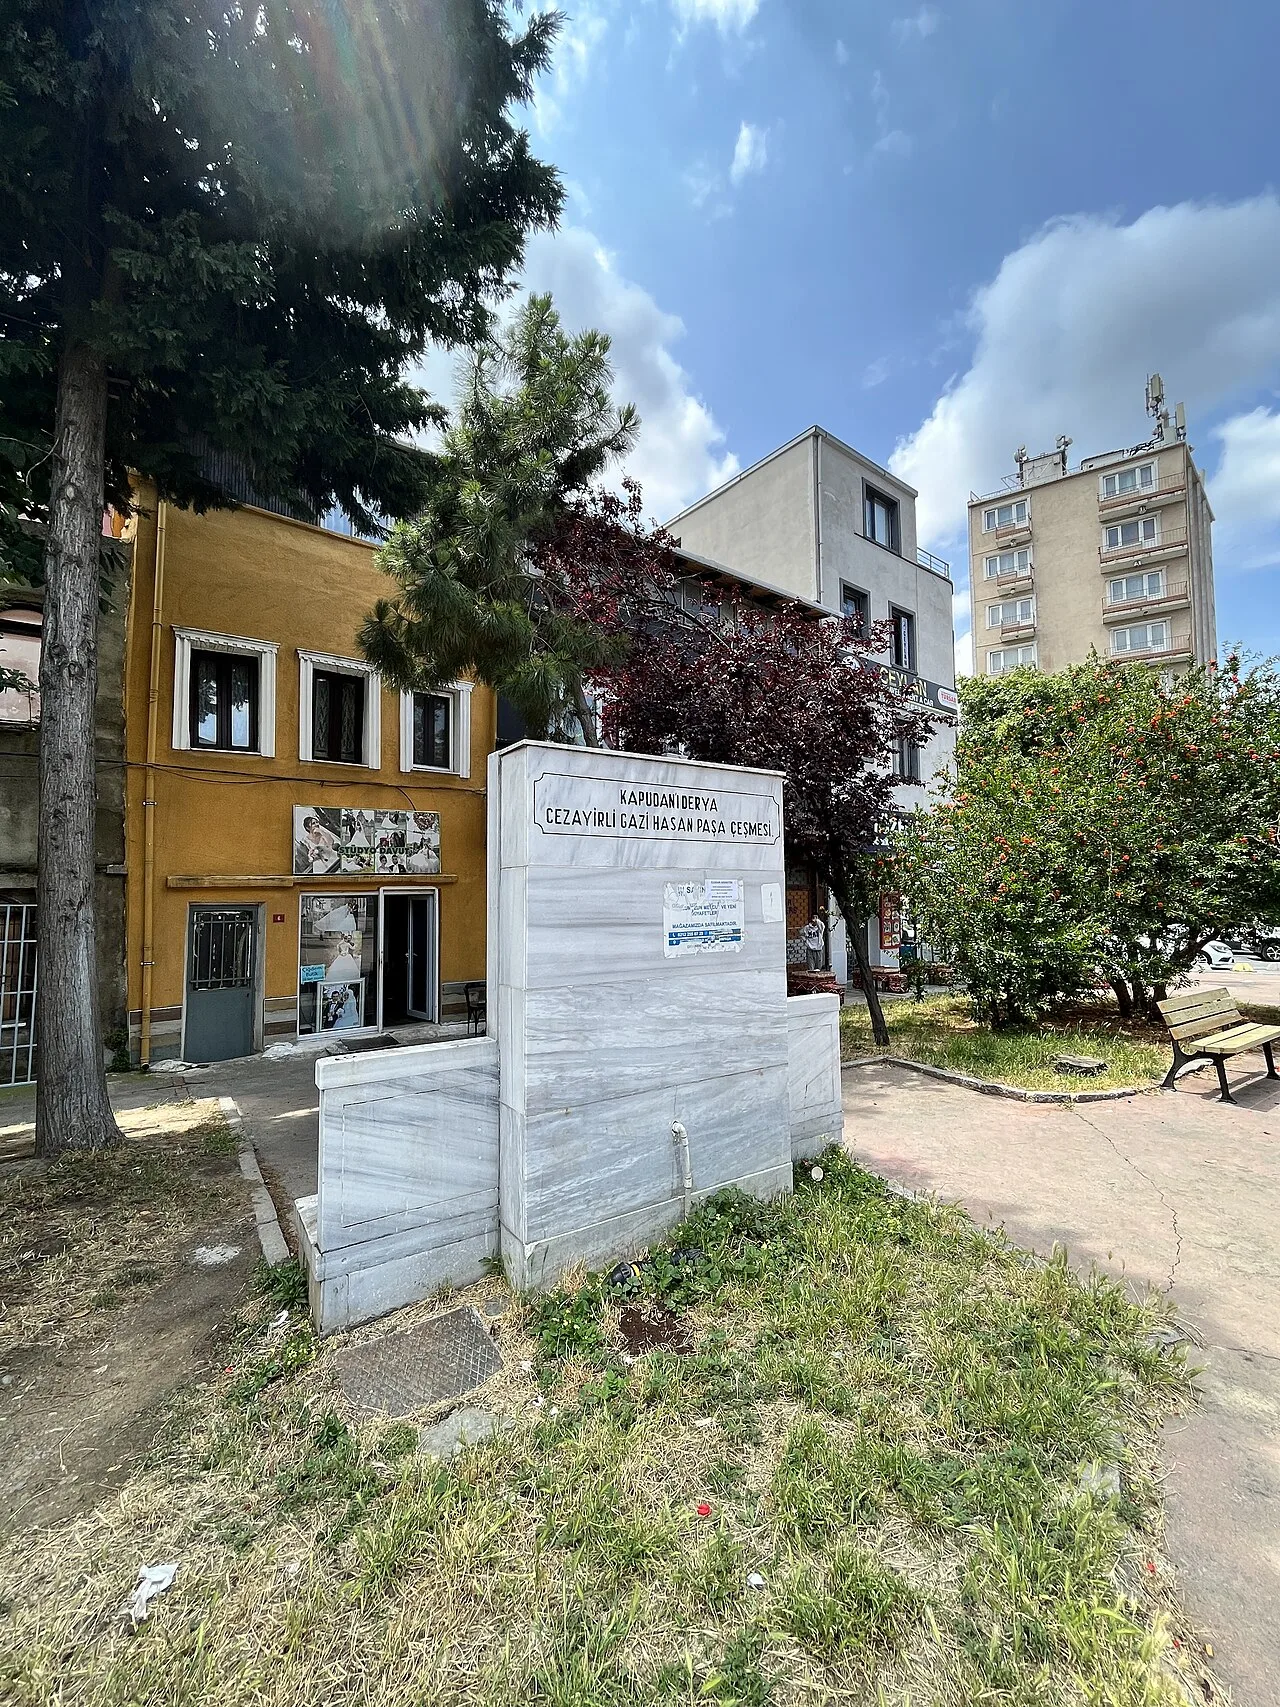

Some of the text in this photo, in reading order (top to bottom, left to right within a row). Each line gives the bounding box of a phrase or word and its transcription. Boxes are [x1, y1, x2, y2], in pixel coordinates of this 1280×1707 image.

[880, 667, 927, 698] CEYLAN
[546, 807, 616, 828] CEZAYİRLİ
[620, 812, 649, 830] GAZİ
[653, 815, 693, 833] HASAN
[697, 818, 726, 838] PAŞA
